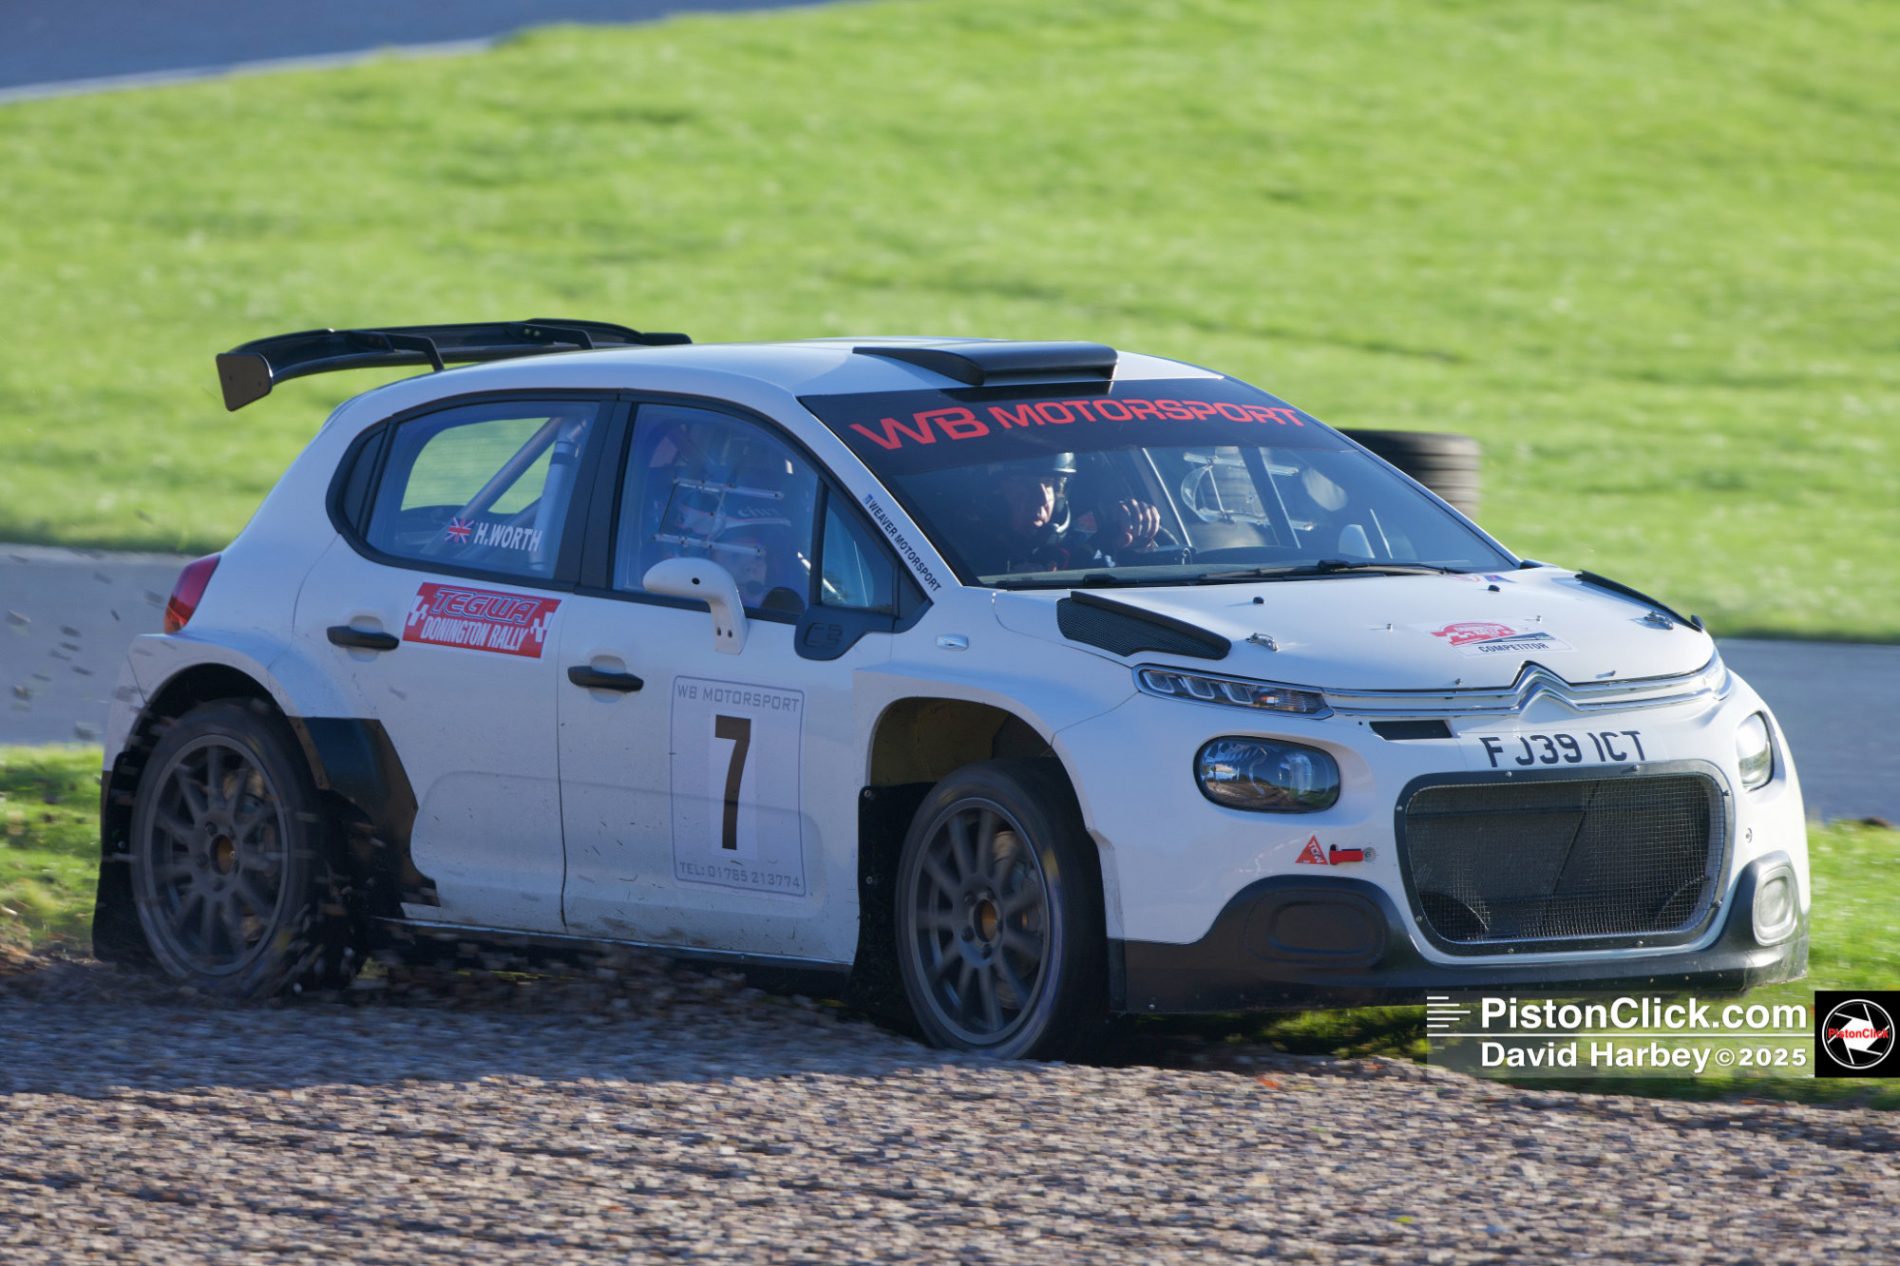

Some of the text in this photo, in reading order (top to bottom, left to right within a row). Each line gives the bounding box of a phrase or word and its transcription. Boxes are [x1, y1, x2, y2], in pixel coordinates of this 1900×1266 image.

[849, 399, 1305, 450] WB MOTORSPORT
[474, 522, 543, 551] H.WORTH
[895, 533, 942, 592] MOTORSPORT
[420, 616, 529, 651] DONINGTON RALLY
[1478, 642, 1550, 653] COMPETITOR
[677, 684, 800, 712] WB MOTORSPORT
[715, 714, 752, 850] 7
[680, 861, 800, 888] TEL: 01785 213774
